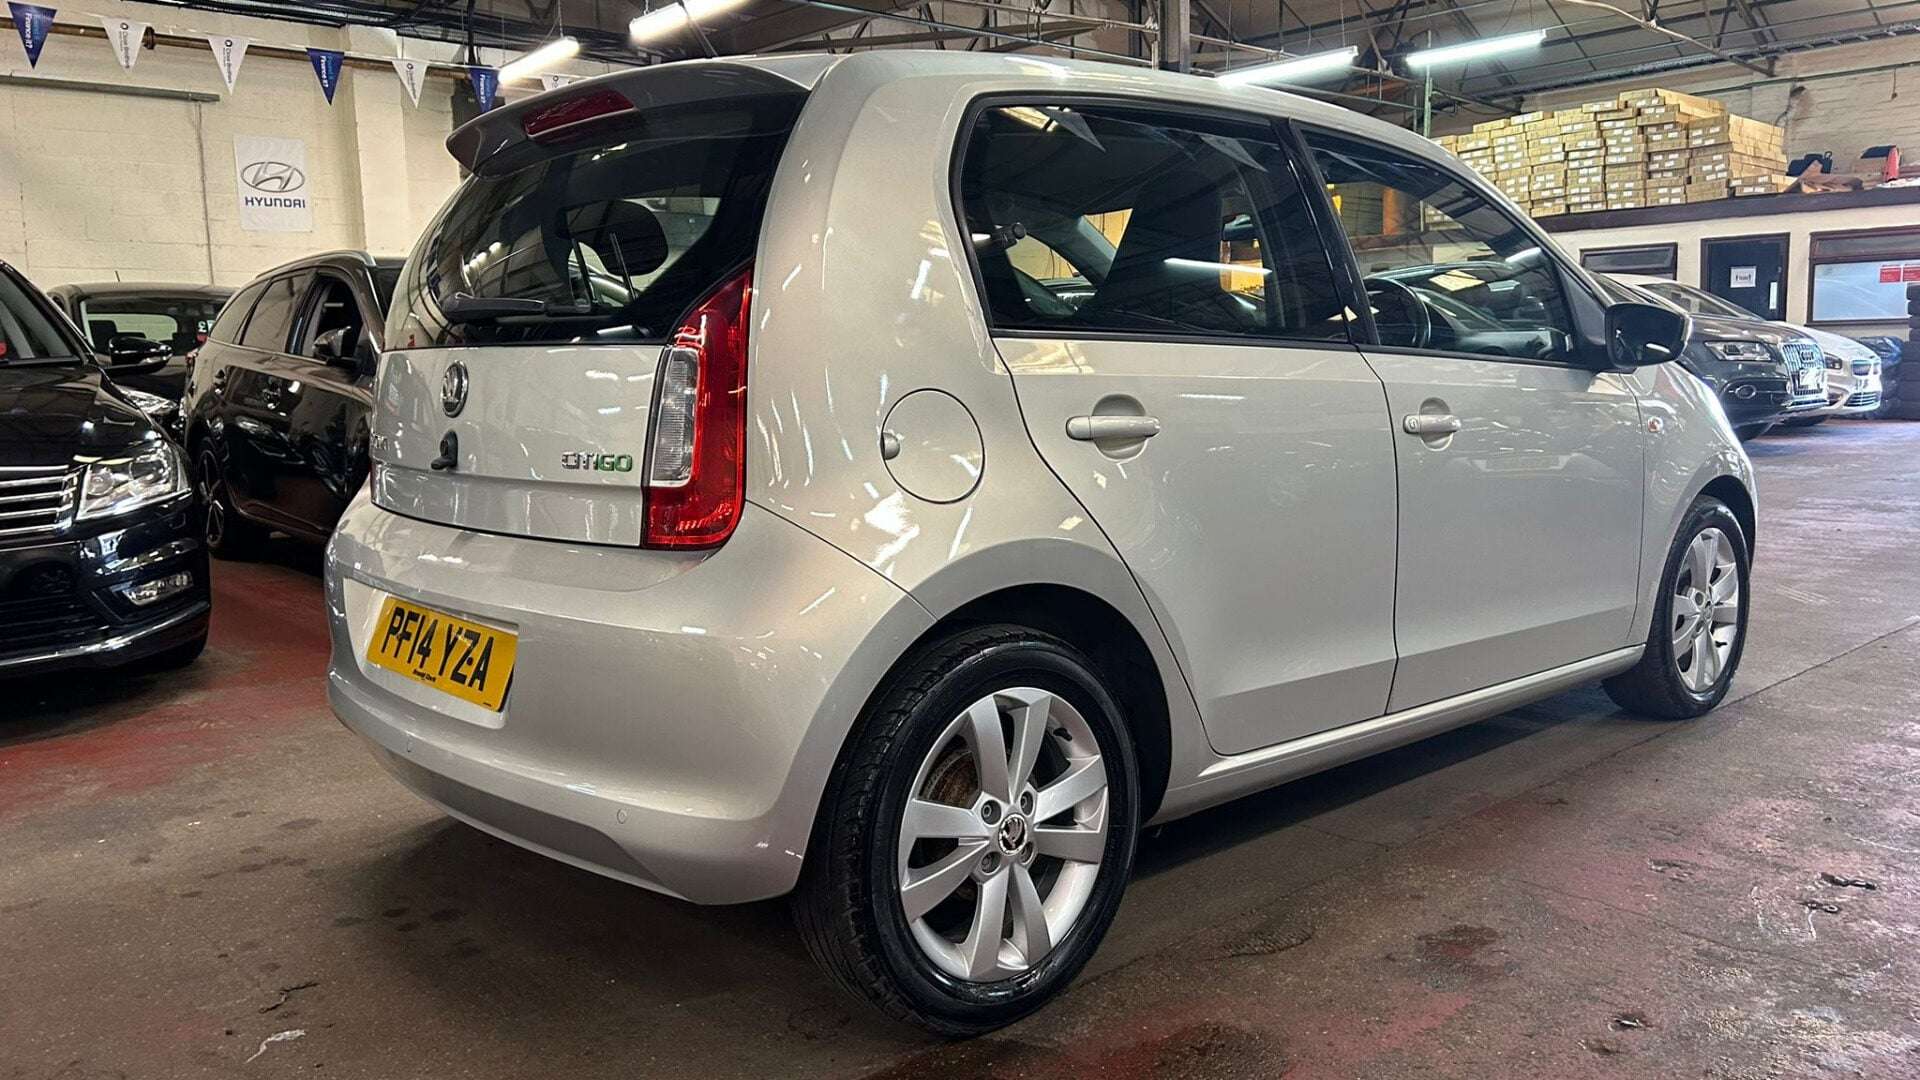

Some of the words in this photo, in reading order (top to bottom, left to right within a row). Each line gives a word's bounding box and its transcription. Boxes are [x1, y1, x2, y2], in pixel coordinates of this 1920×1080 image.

[245, 196, 306, 209] HYUNDAI
[561, 453, 633, 472] CITIGO
[381, 606, 438, 669] PF14
[438, 623, 494, 692] YZA
